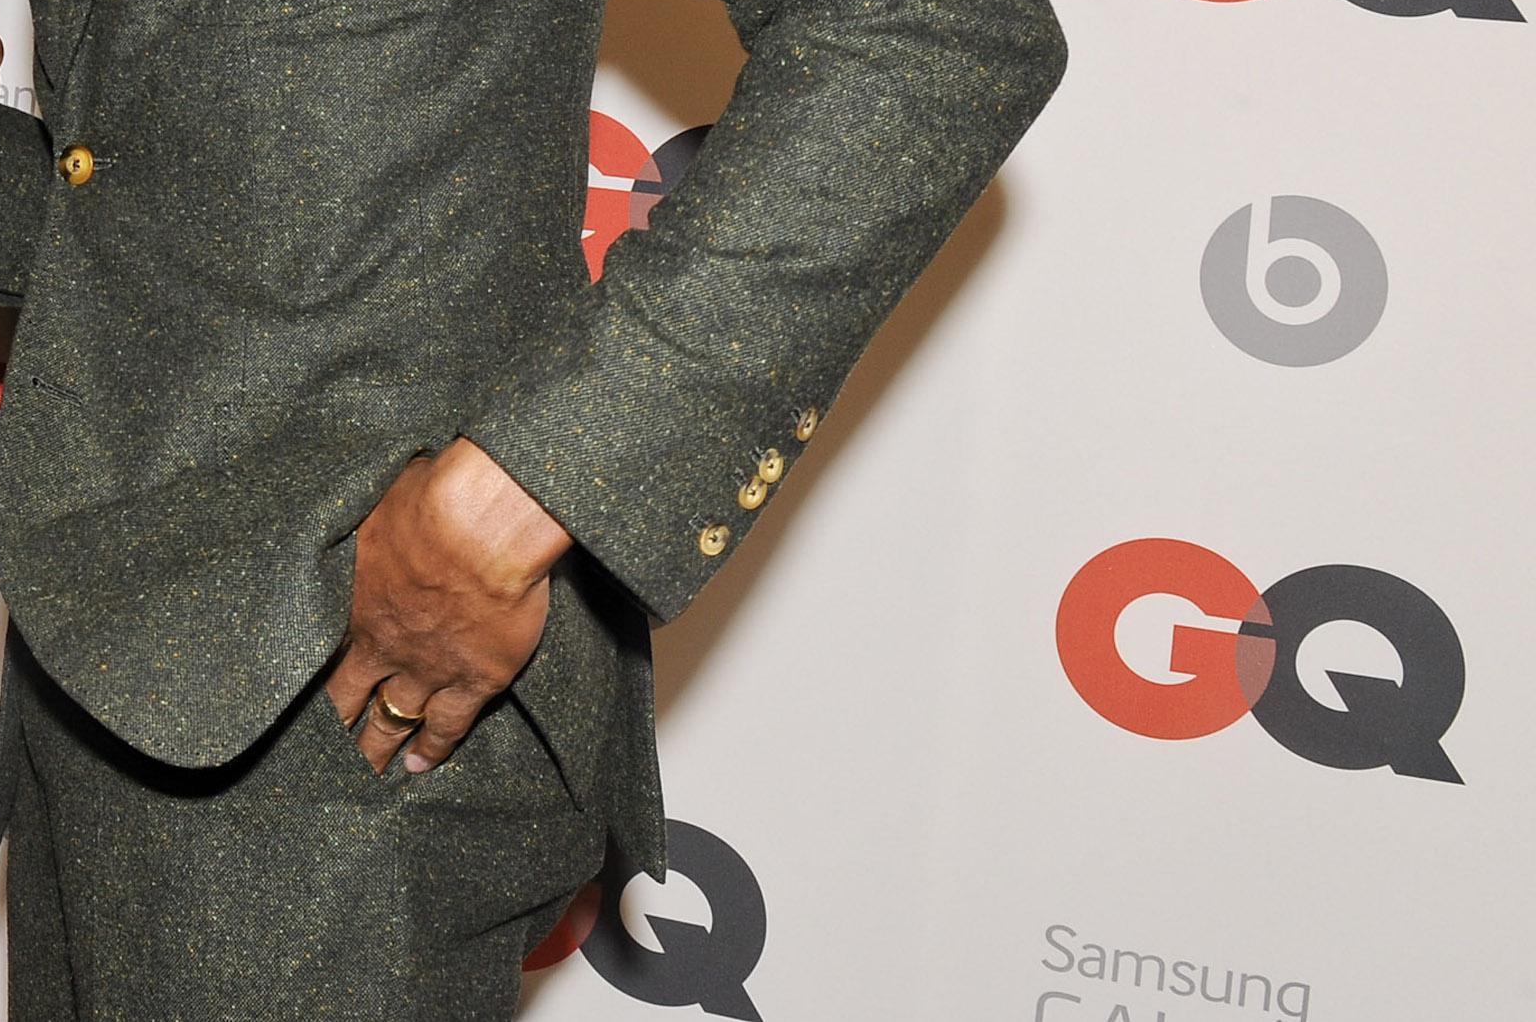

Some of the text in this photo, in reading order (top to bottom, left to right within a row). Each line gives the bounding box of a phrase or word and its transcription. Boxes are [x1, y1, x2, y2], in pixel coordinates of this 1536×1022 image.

[1055, 537, 1466, 786] GQ
[521, 817, 767, 1022] Q
[1041, 925, 1311, 1022] Samsung
